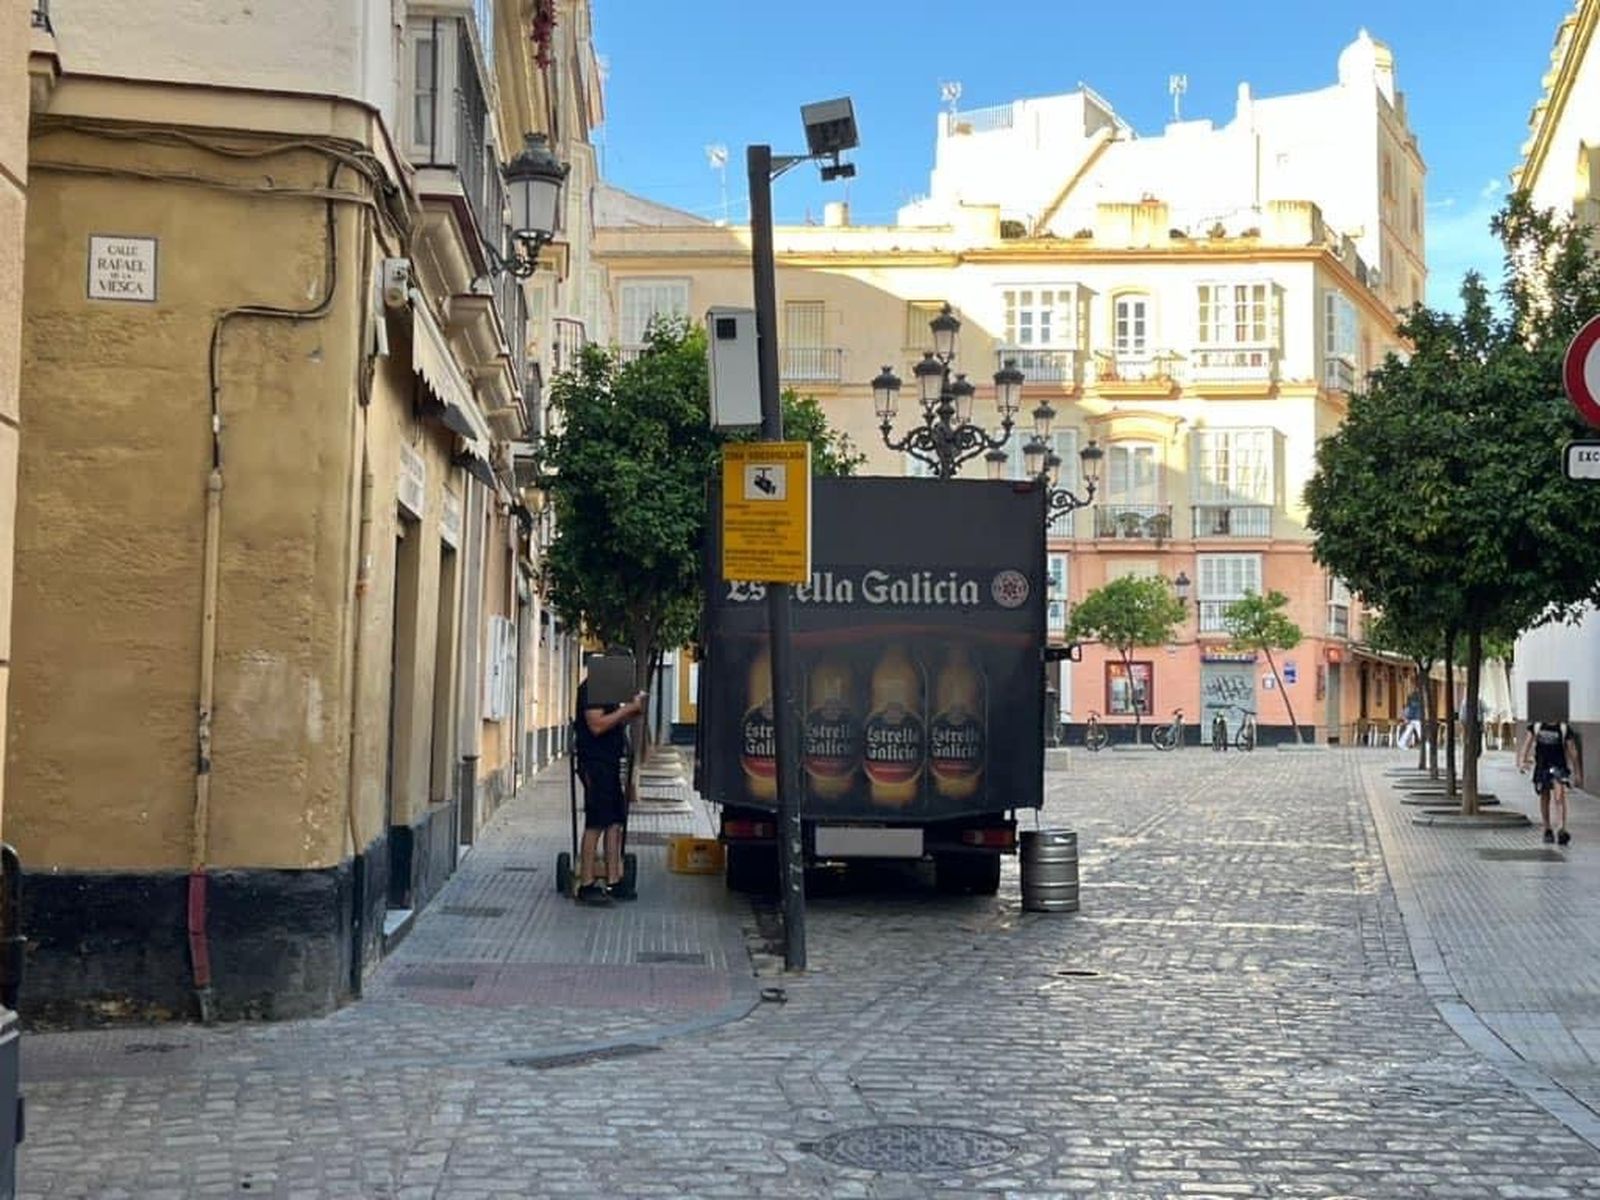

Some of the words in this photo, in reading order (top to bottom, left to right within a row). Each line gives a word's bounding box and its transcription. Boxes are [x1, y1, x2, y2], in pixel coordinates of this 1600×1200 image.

[107, 245, 139, 256] CALLE
[97, 257, 146, 273] RAFAEL
[99, 279, 144, 294] VIESCA
[726, 572, 855, 603] Esella
[862, 570, 980, 605] Galicia
[744, 722, 775, 739] Estr
[745, 738, 776, 756] Gali
